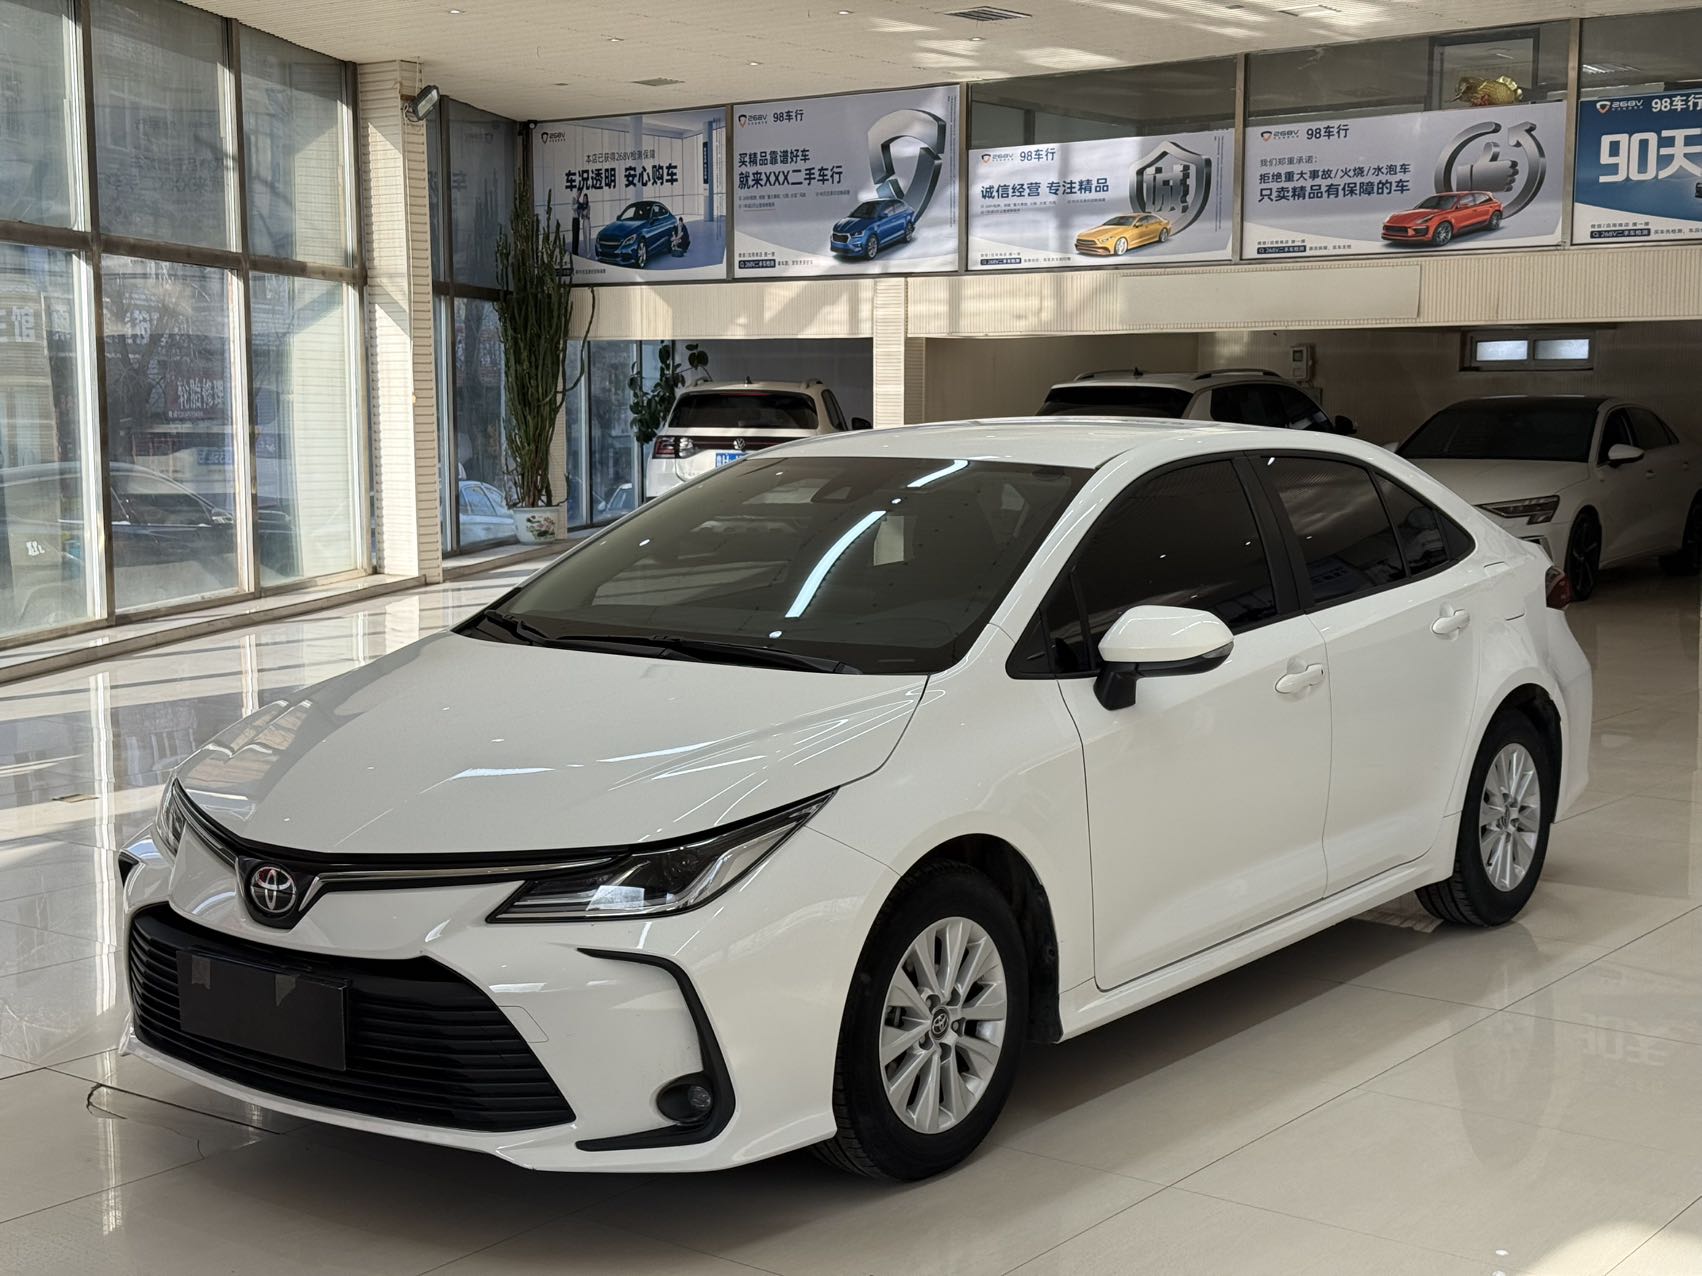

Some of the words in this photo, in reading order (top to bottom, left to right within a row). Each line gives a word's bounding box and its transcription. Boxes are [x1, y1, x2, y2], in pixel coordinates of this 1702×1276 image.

[1651, 94, 1702, 112] 98车行
[747, 113, 768, 122] 268V
[773, 109, 805, 123] 98车行
[1273, 129, 1299, 137] 268V
[1306, 123, 1350, 140] 98车行
[737, 148, 811, 168] 买精品靠谱好车
[1019, 147, 1056, 162] 98车行
[1598, 127, 1702, 183] 90天
[565, 167, 617, 192] 车况透明
[624, 163, 679, 188] 安心购车
[737, 165, 843, 190] 就来XXX二手车行
[1258, 163, 1411, 184] 拒绝重大事故/火烧/水泡车
[980, 182, 1041, 200] 诚信经营
[1046, 178, 1109, 196] 专注精品
[1257, 179, 1411, 203] 只卖精品有保障的车
